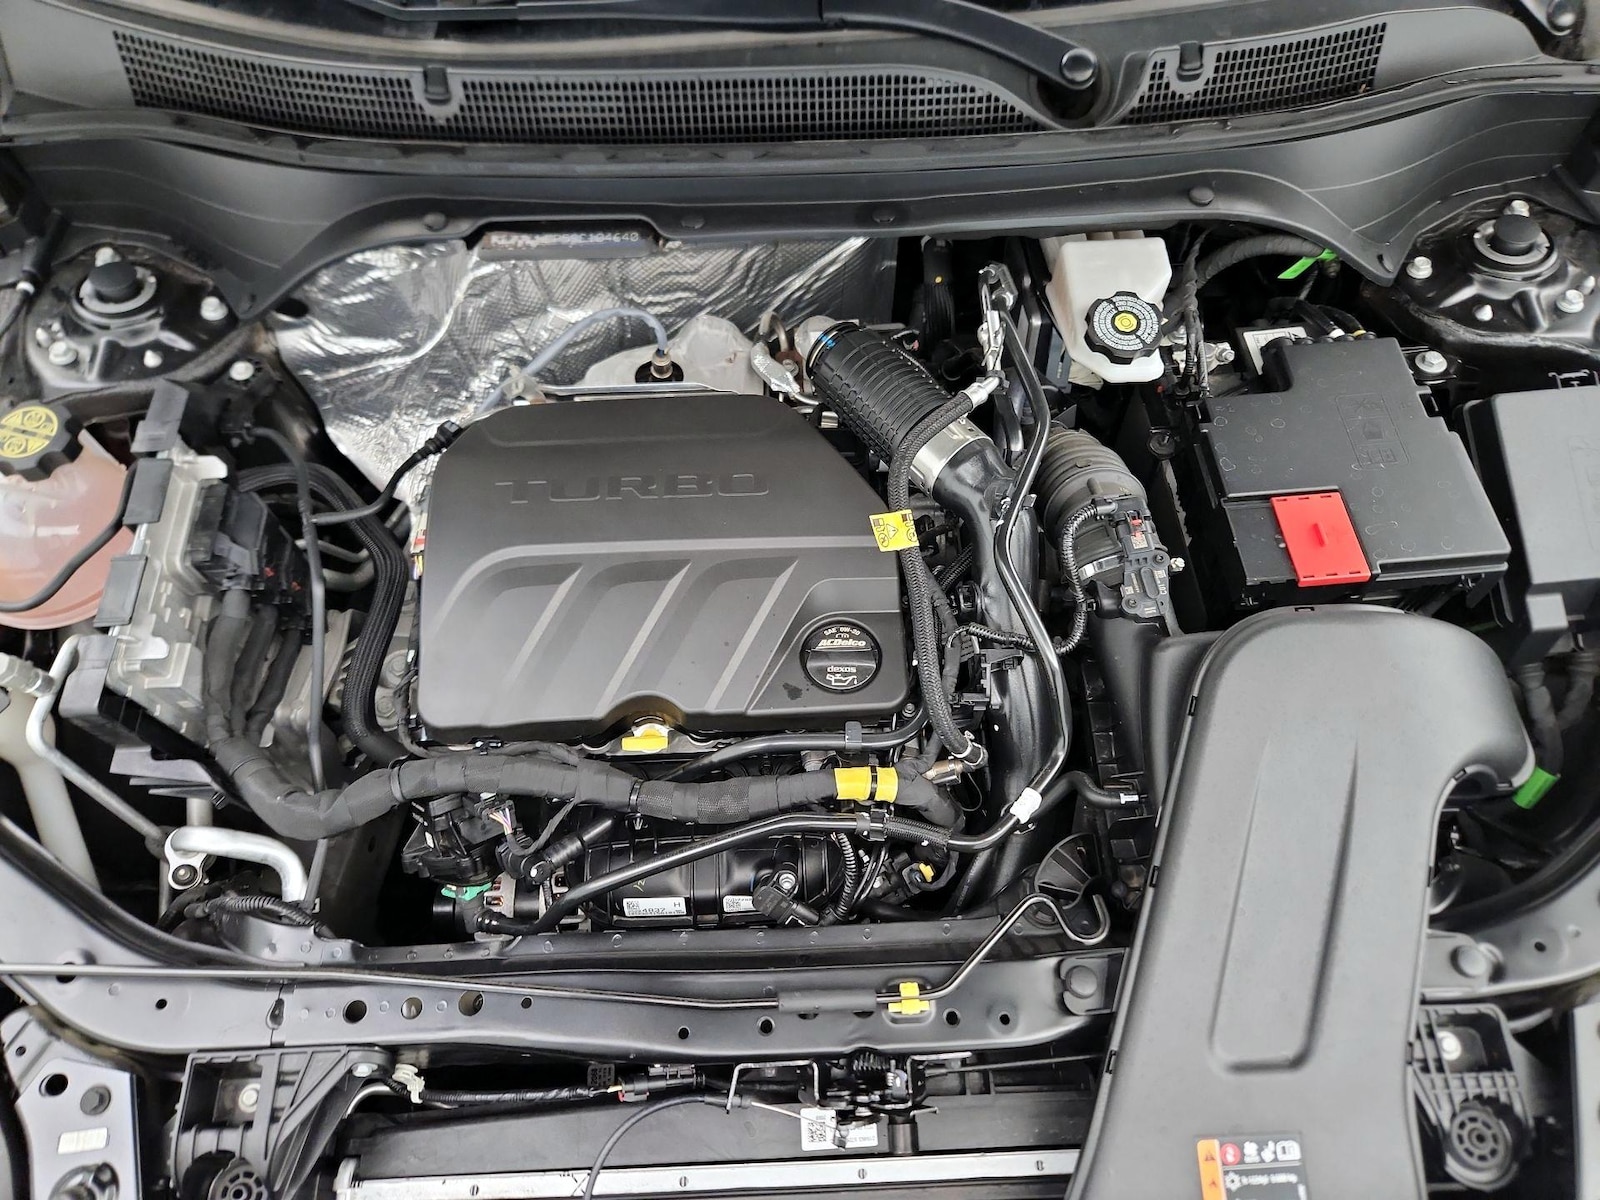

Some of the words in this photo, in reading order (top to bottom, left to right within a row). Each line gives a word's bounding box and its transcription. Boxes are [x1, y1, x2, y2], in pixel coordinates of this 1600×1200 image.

[495, 473, 769, 504] TURBO
[840, 627, 860, 635] 0W-20
[818, 639, 866, 647] ACDelco
